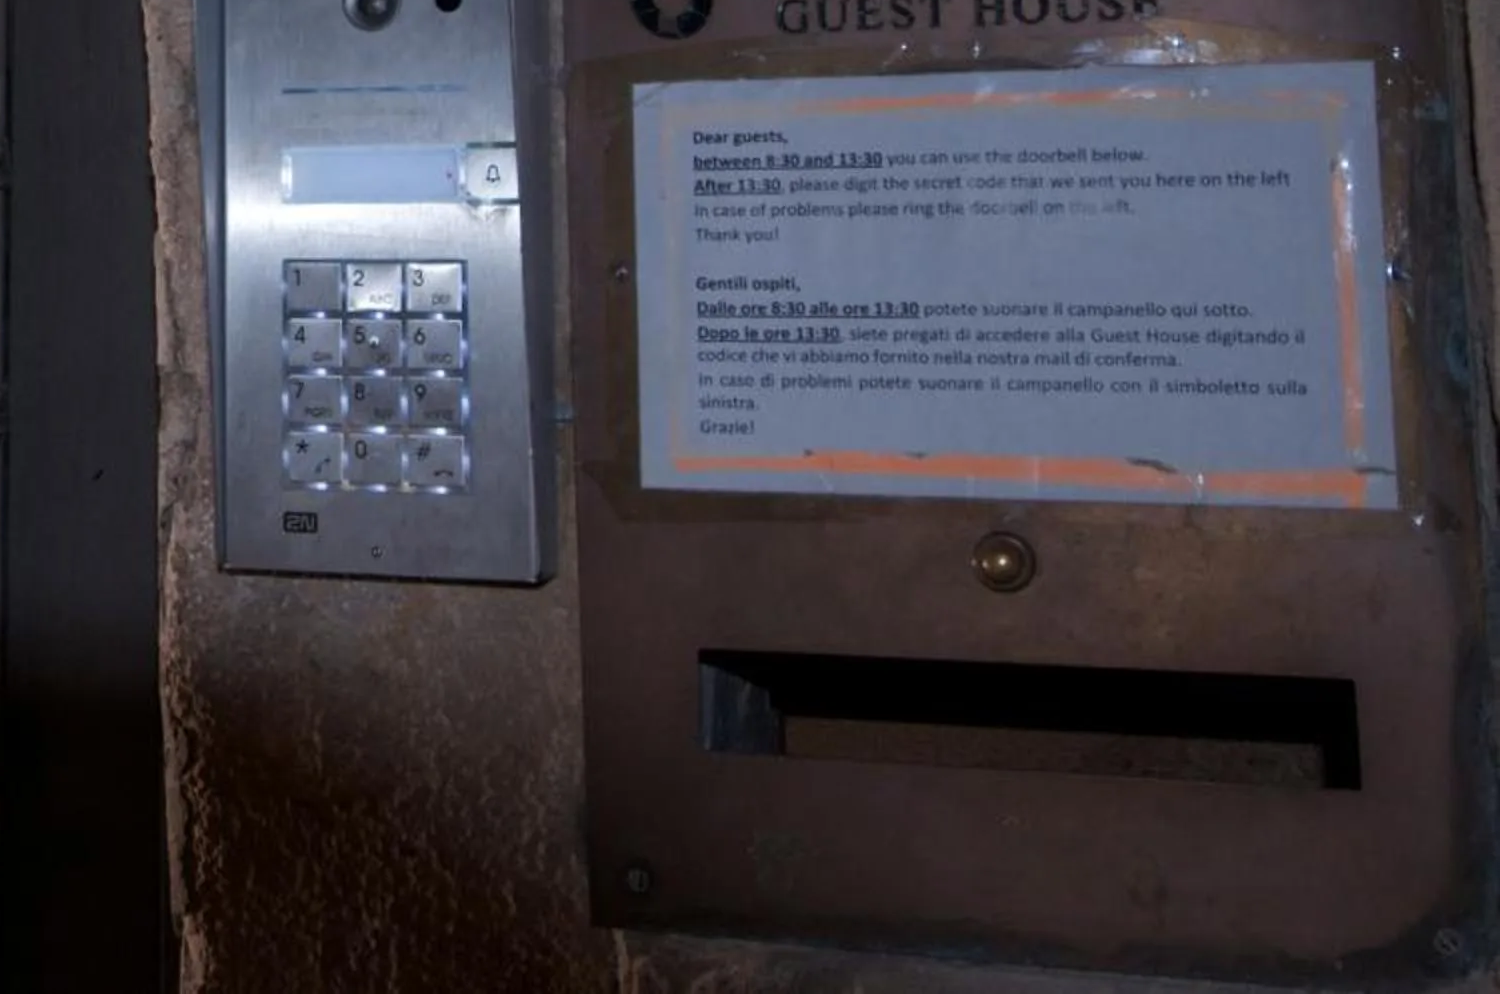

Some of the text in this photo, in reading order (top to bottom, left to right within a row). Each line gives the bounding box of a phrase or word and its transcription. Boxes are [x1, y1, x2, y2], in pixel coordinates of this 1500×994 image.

[693, 130, 788, 146] Dear guests,
[693, 147, 1148, 170] between 8:30 and 13:30 you can use the doorbell below.
[693, 179, 732, 195] After
[789, 176, 839, 193] please
[844, 176, 877, 193] digit
[883, 176, 909, 190] the
[913, 176, 962, 190] secret
[966, 176, 1005, 189] code
[1011, 175, 1044, 189] that
[1050, 177, 1074, 189] we
[1079, 175, 1114, 189] sent
[1120, 176, 1151, 191] you
[1156, 172, 1196, 188] here
[1201, 174, 1223, 187] on
[1227, 171, 1256, 187] the
[1260, 170, 1291, 187] left
[713, 205, 746, 218] case
[750, 202, 766, 217] of
[771, 202, 844, 220] problems
[848, 202, 898, 219] please
[903, 201, 934, 219] ring
[938, 201, 965, 216] the
[1043, 203, 1065, 216] on
[696, 227, 780, 243] Thank you!
[353, 269, 365, 287] 2
[413, 269, 424, 287] 3
[696, 276, 801, 292] Gentili ospiti,
[697, 301, 1253, 319] Dalle ore 8:30 alle ore 13:30 potete suonare il campanello qui sotto.
[295, 326, 425, 345] 4 5 6
[697, 326, 740, 343] Dopo
[744, 326, 759, 342] le
[763, 329, 791, 343] ore
[849, 327, 887, 341] siete
[892, 328, 950, 345] pregati
[955, 327, 971, 342] di
[975, 327, 1049, 342] accedere
[1055, 328, 1085, 342] alla
[1090, 328, 1141, 343] Guest
[1146, 329, 1200, 344] House
[1205, 329, 1290, 347] digitando
[1294, 329, 1306, 344] il
[697, 348, 1182, 367] codice che vi abbiamo fornito nella nostra mail di conferma.
[292, 381, 426, 401] 7 8 9
[719, 375, 755, 387] caso
[760, 373, 775, 388] di
[781, 373, 853, 390] problemi
[858, 376, 912, 391] potete
[918, 377, 984, 391] suonare
[990, 376, 1000, 391] il
[1006, 377, 1104, 394] campanello
[1110, 380, 1141, 393] con
[1149, 377, 1159, 393] il
[1166, 378, 1260, 395] simboletto
[1267, 380, 1308, 396] sulla
[699, 395, 759, 410] sinistra.
[700, 419, 755, 435] Grazie!
[355, 440, 366, 459] 0
